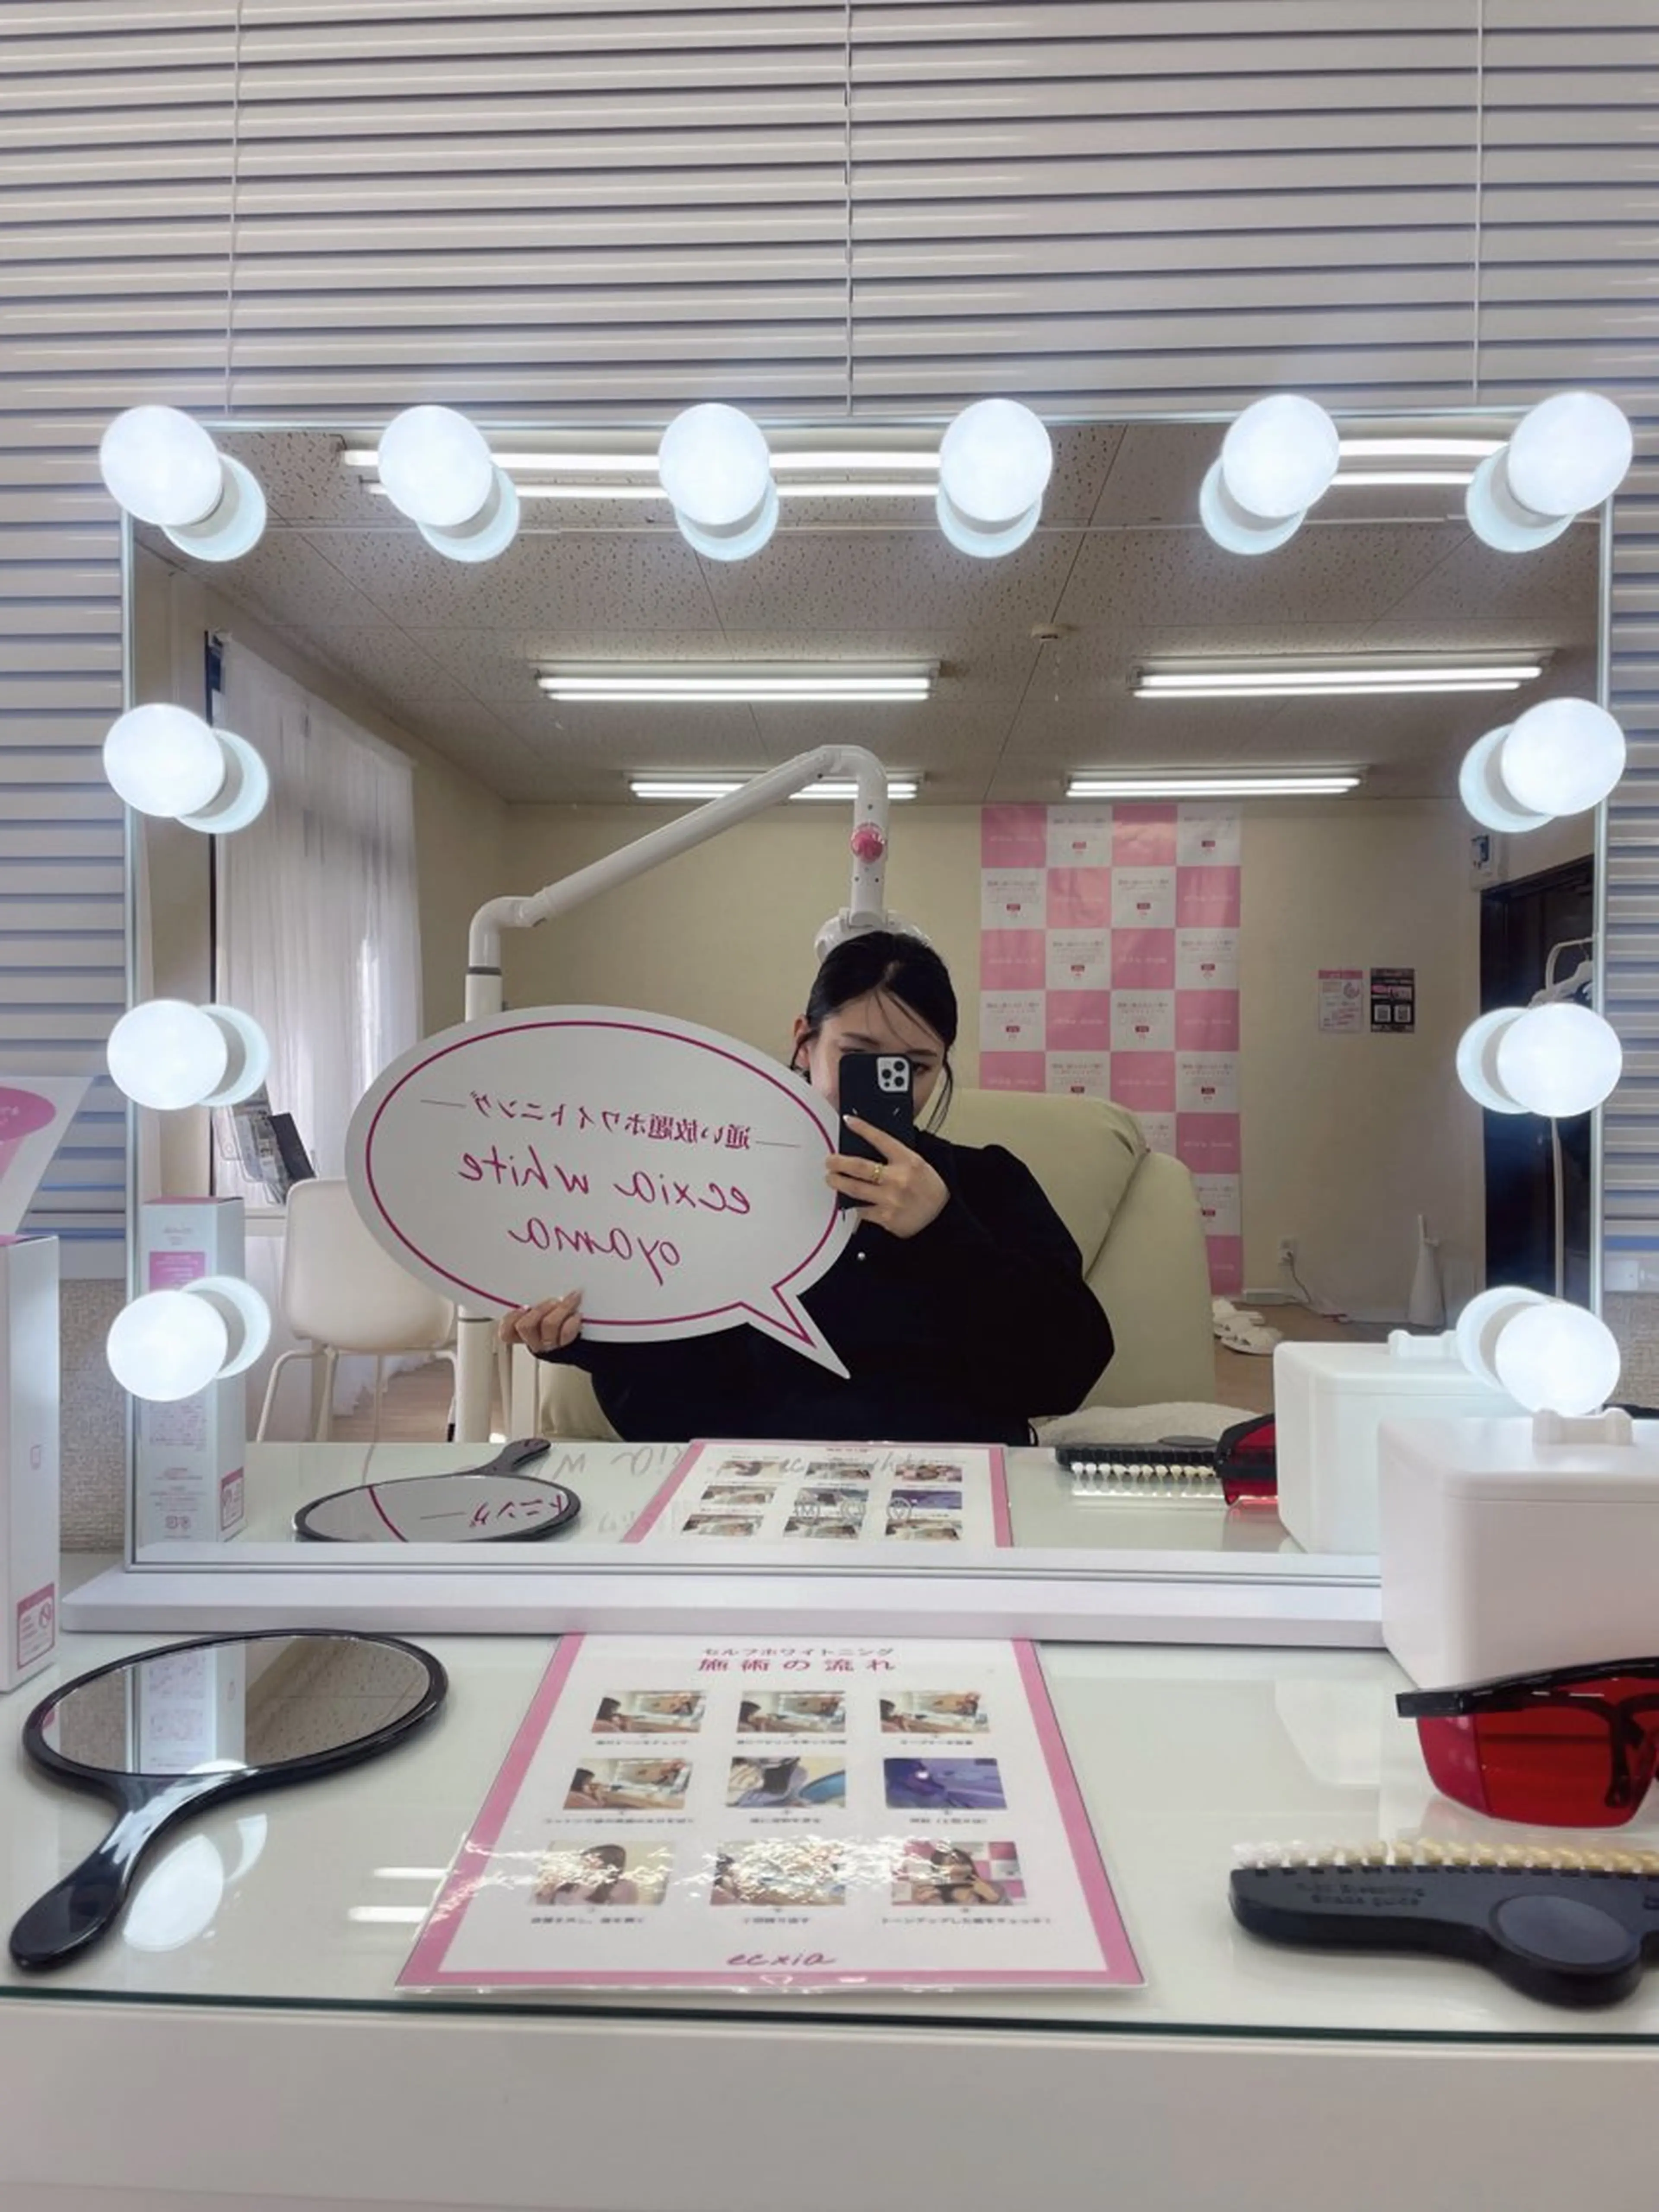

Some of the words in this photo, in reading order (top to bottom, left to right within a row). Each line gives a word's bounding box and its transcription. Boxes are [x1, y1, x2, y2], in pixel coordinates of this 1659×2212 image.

[702, 1647, 895, 1657] セルフホワイトニング
[697, 1658, 897, 1672] 施術の流れ
[727, 1950, 838, 1966] ecxia
